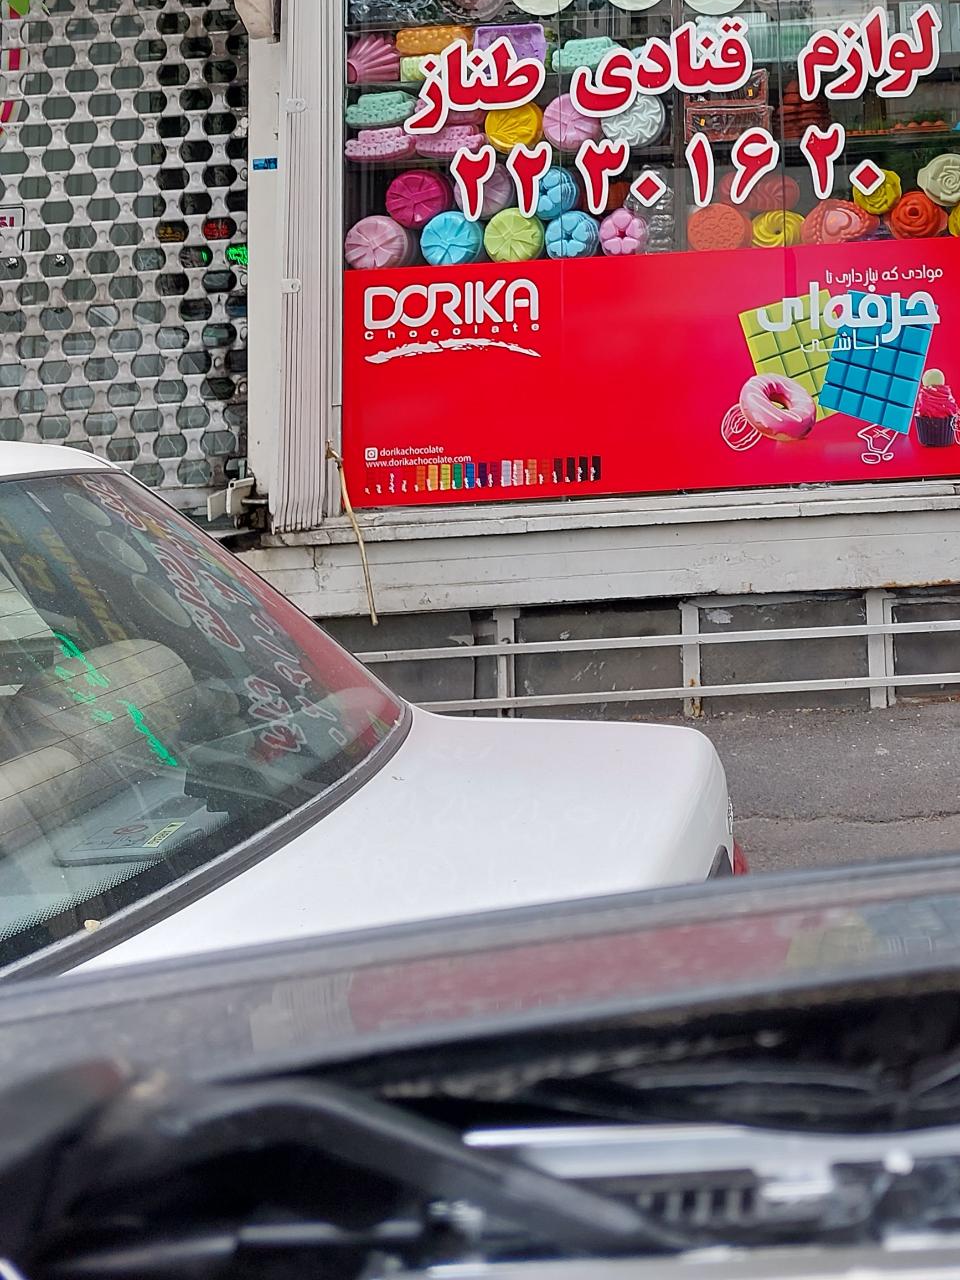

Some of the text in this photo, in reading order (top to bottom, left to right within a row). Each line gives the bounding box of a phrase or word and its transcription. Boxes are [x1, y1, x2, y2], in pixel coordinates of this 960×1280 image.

[405, 3, 943, 134] لوازم قنادی طناز
[835, 268, 862, 288] داری
[882, 265, 898, 282] که
[901, 263, 943, 282] موادی
[364, 278, 539, 330] DORIKA
[380, 445, 444, 458] dorikachocolate
[366, 454, 472, 469] www.dorikachocolate.com
